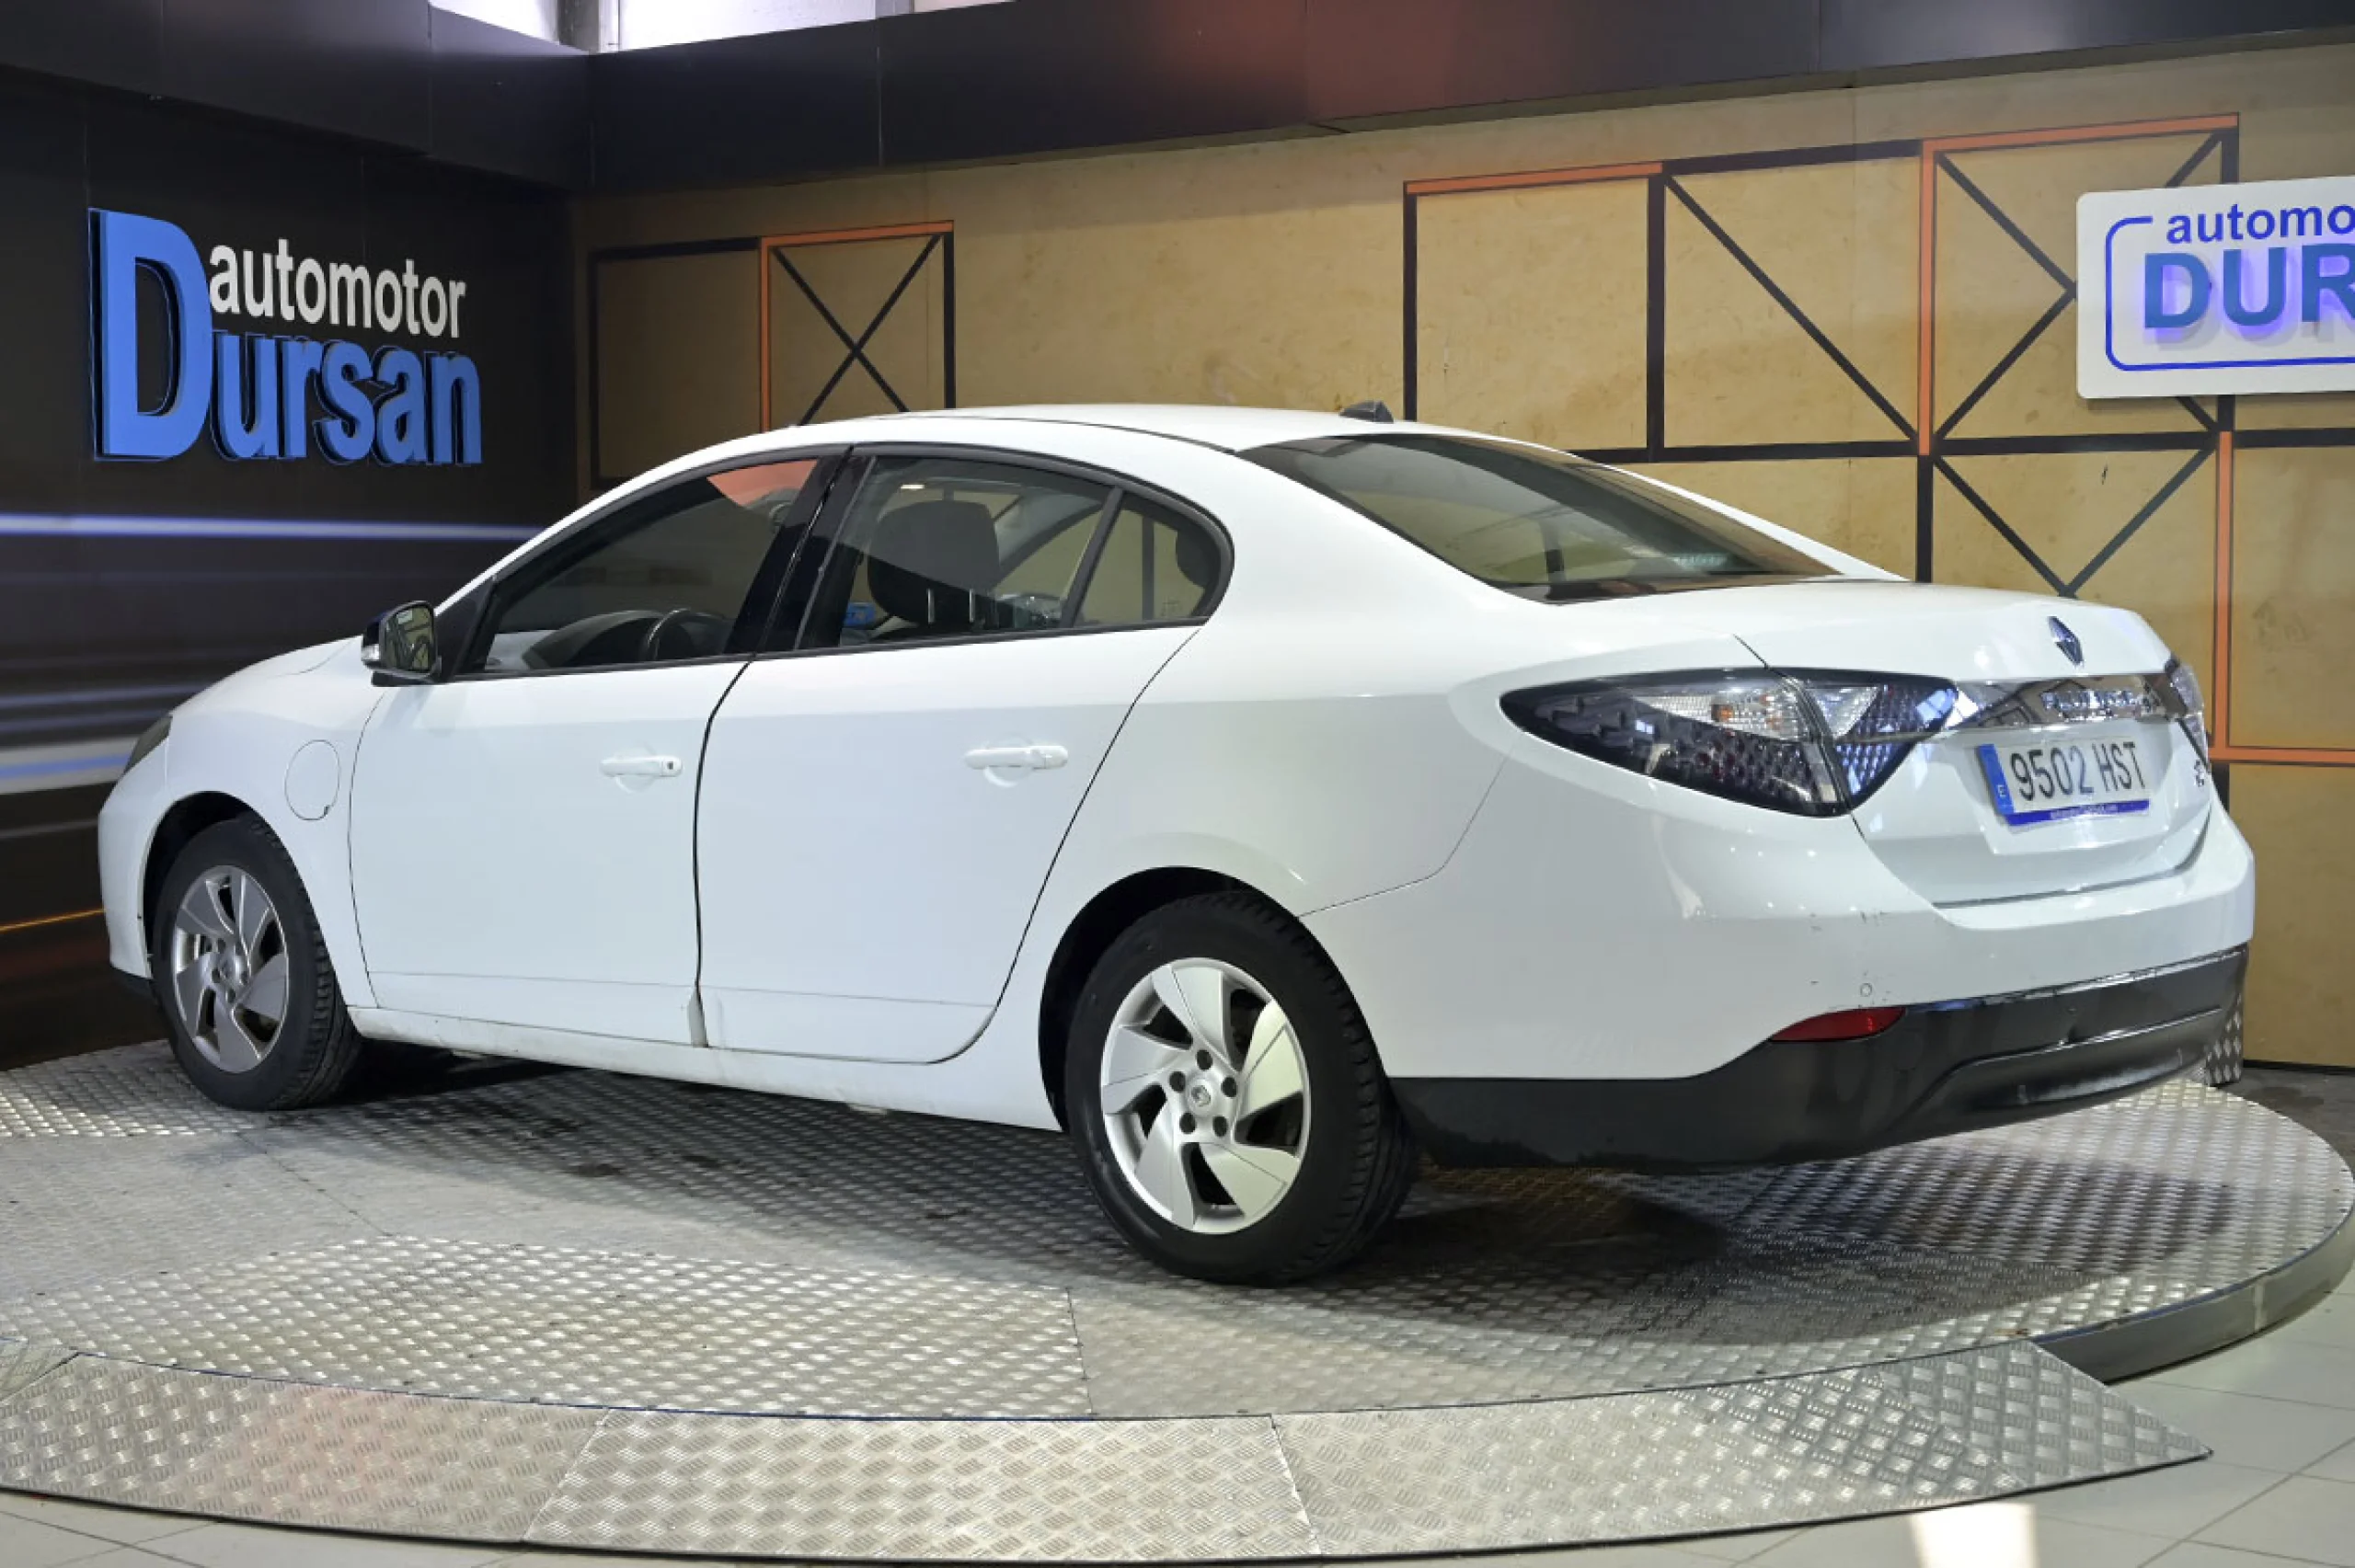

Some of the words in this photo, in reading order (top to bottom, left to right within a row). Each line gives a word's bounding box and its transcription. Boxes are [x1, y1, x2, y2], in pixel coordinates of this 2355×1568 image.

[209, 238, 466, 338] automotor
[2144, 243, 2355, 330] DUR
[88, 207, 483, 465] Dursan
[1997, 784, 2006, 797] E
[2010, 746, 2095, 801] 9502
[2092, 741, 2145, 792] HST
